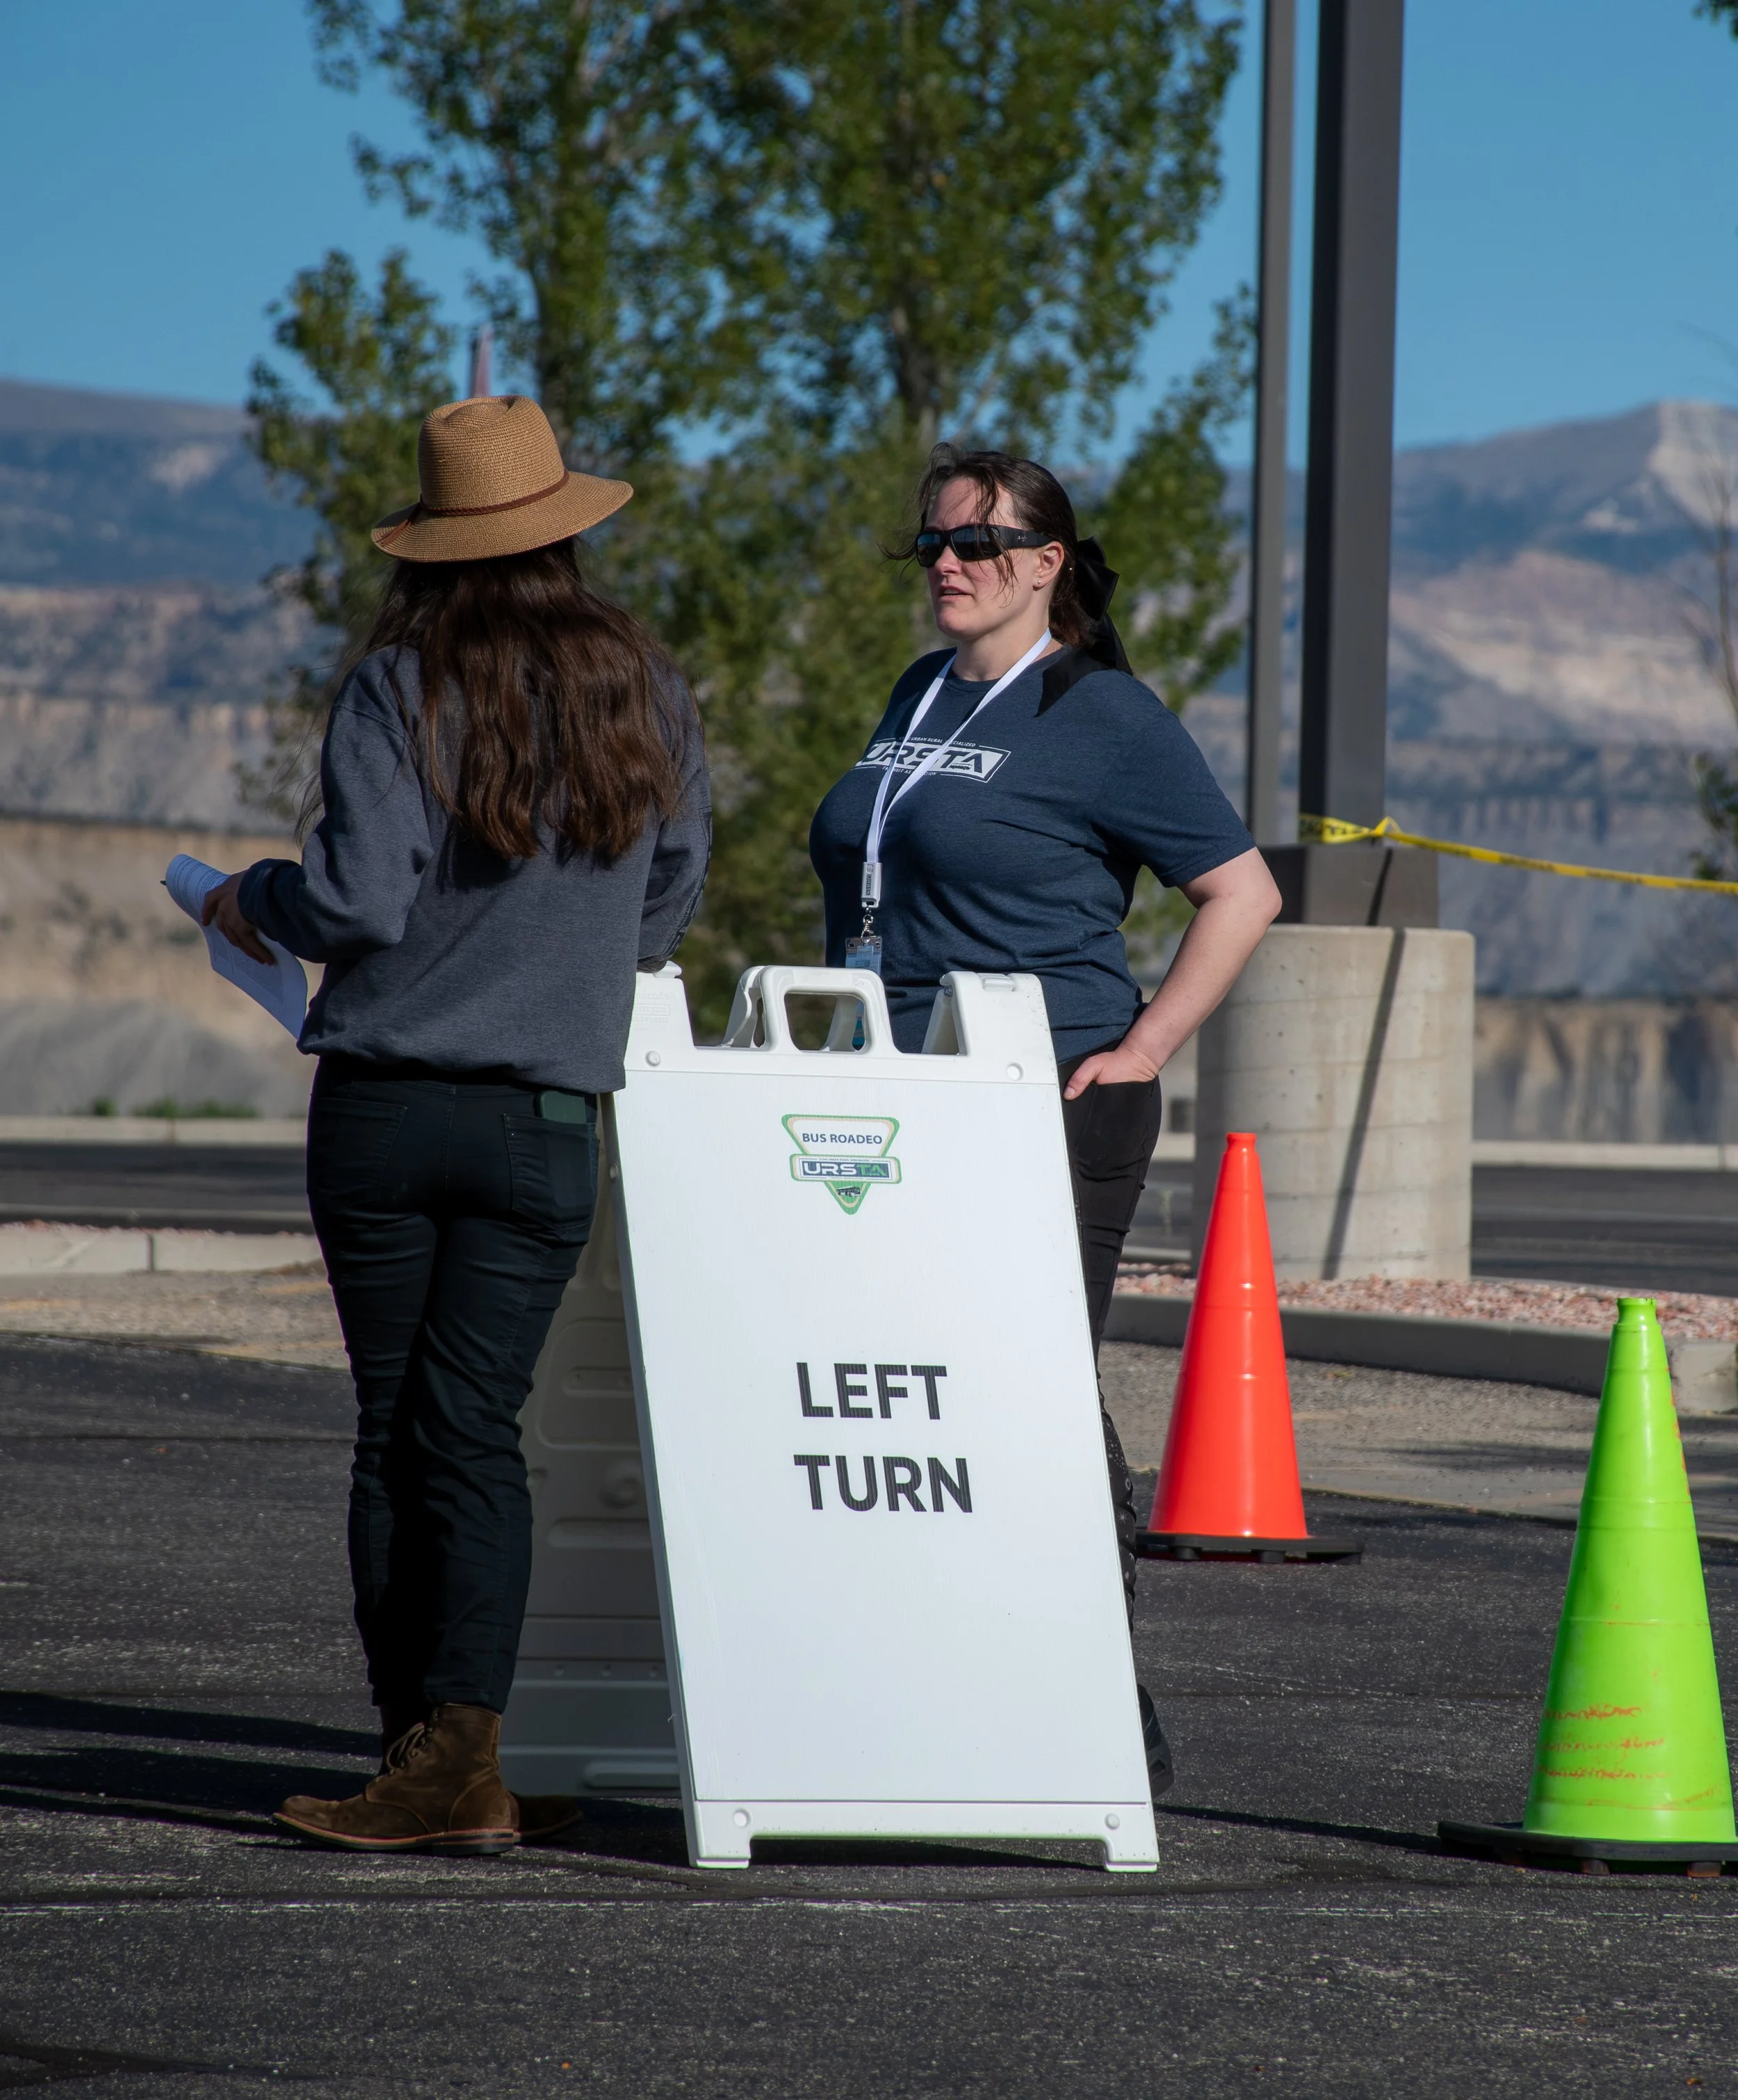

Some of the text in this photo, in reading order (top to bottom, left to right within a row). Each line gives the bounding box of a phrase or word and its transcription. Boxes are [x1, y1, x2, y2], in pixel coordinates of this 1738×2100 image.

[802, 1133, 882, 1144] BUS ROADEO
[804, 1162, 887, 1177] URSTA
[796, 1362, 948, 1420] LEFT
[793, 1454, 973, 1513] TURN
